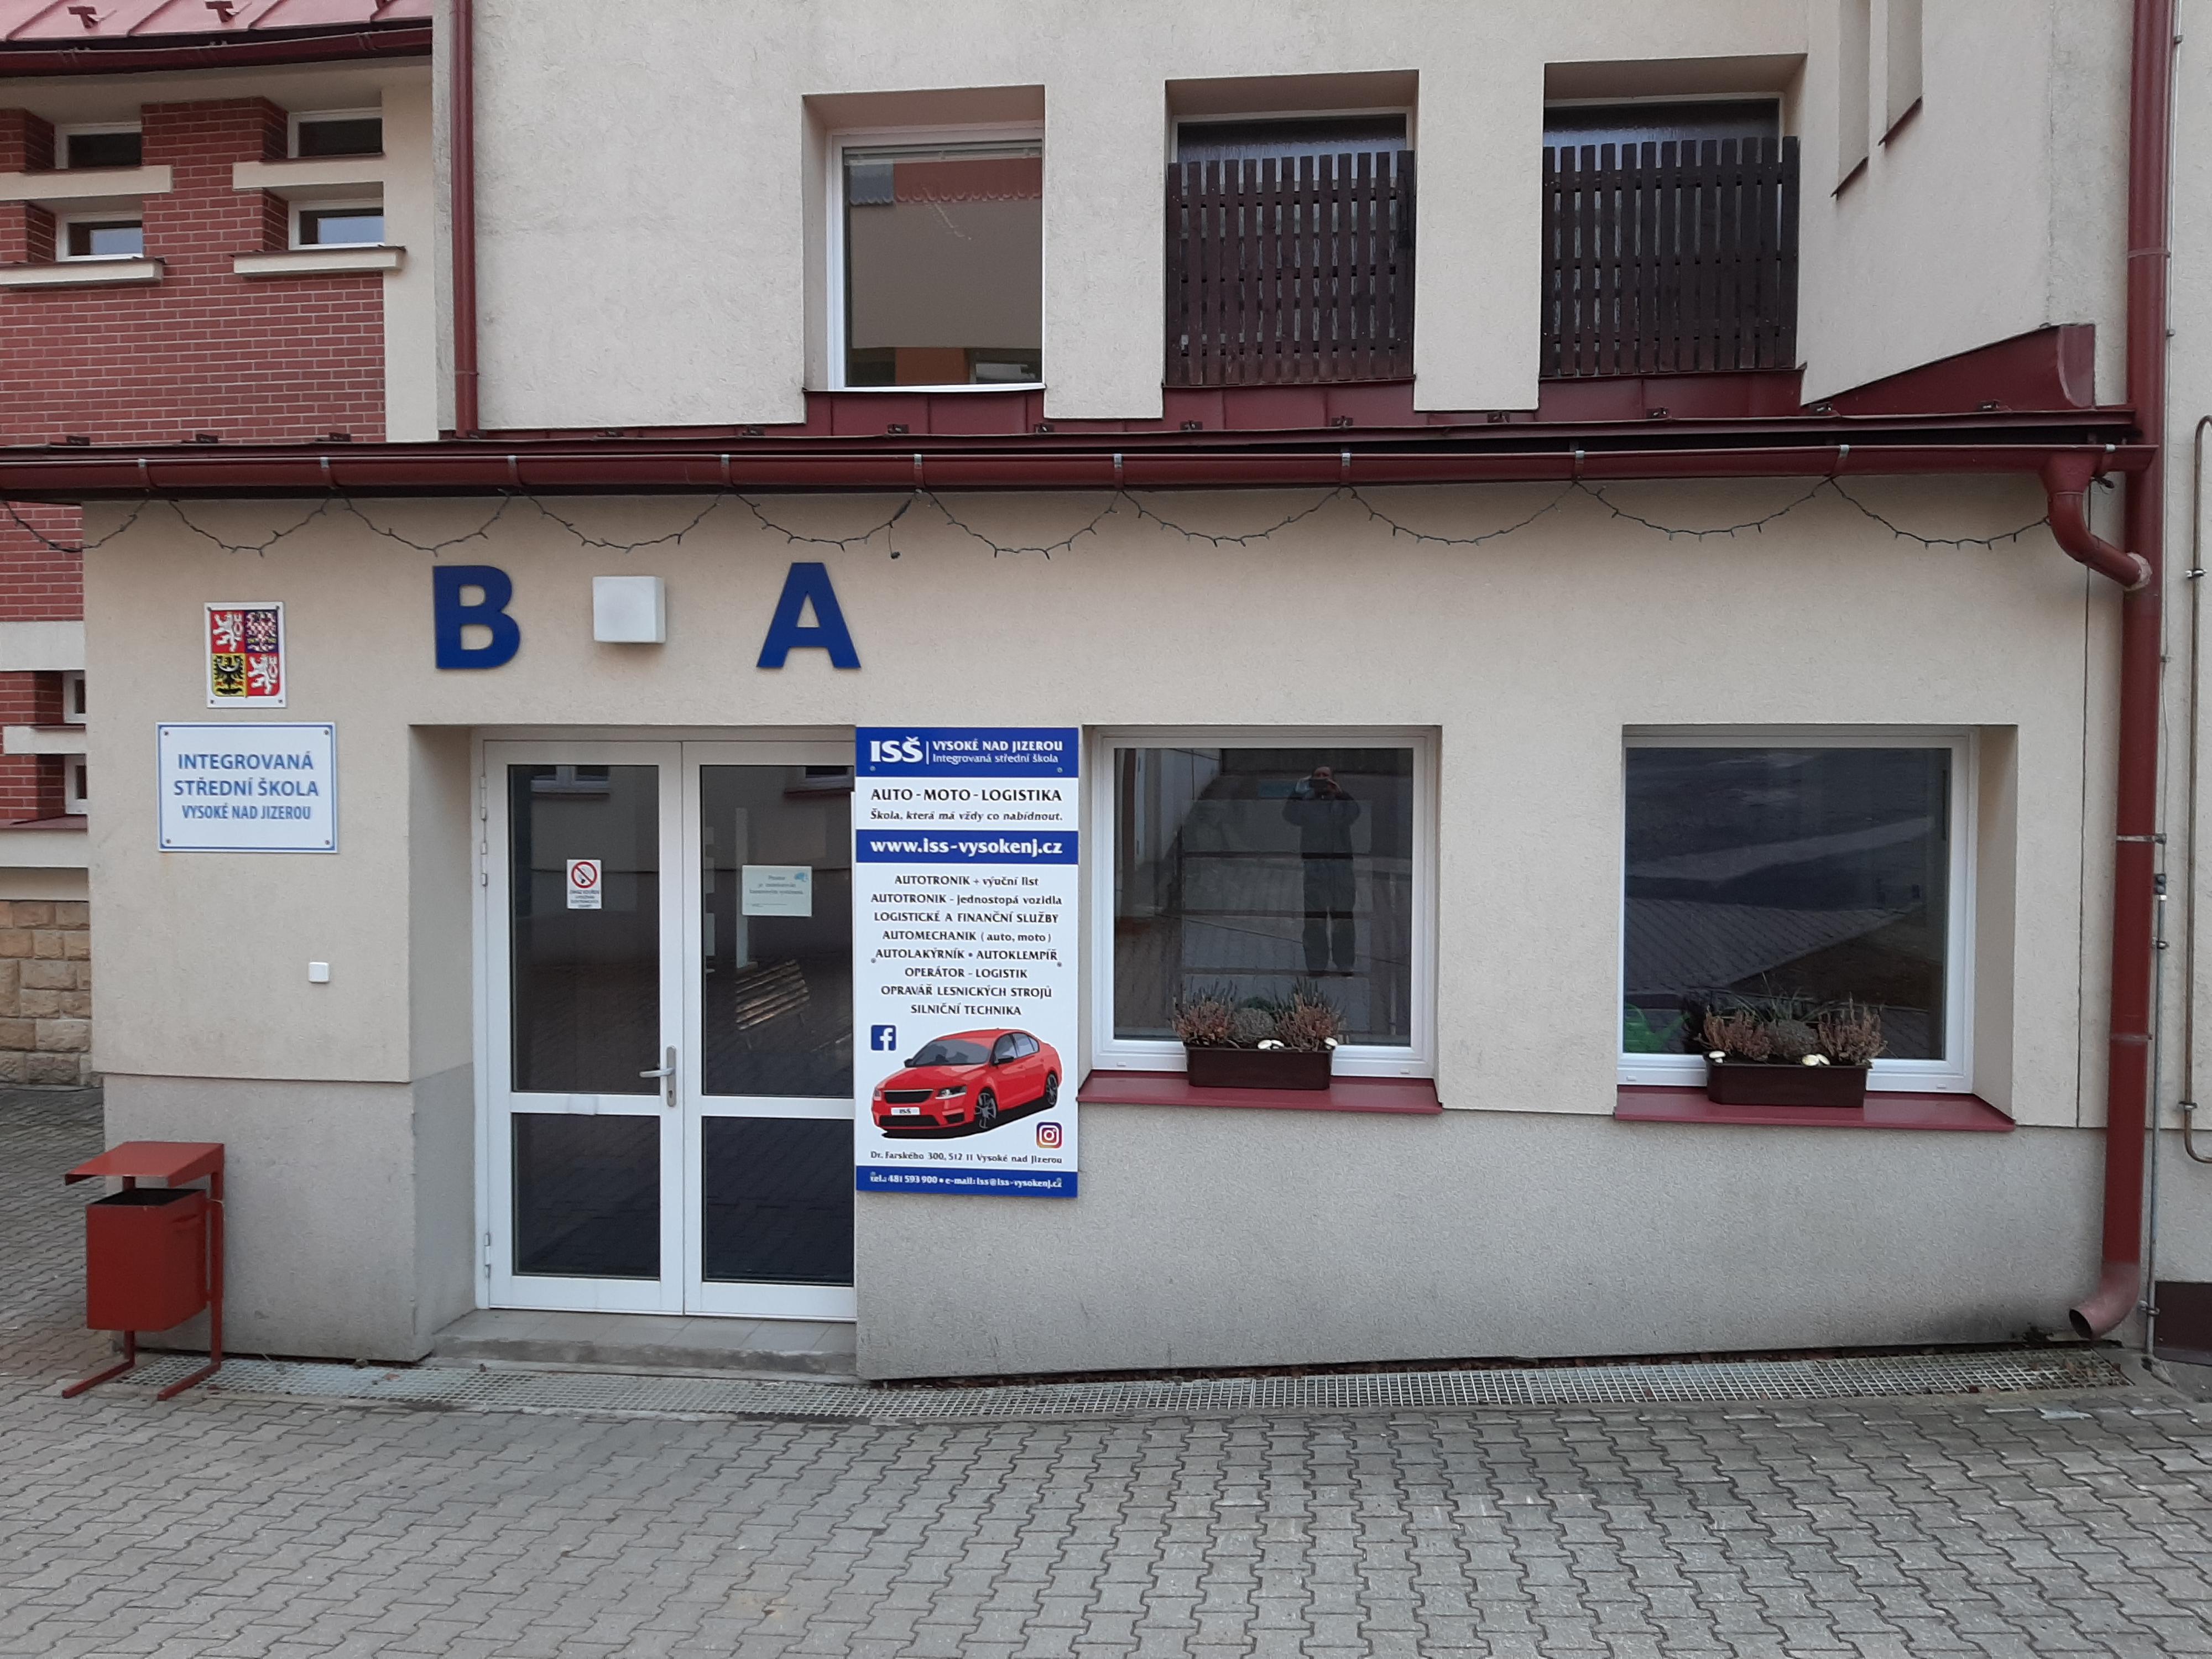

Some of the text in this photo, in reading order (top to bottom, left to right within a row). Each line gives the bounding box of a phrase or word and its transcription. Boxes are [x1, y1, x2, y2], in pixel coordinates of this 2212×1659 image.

[432, 565, 520, 669] B
[756, 562, 862, 668] A
[870, 737, 923, 763] ISŠ
[933, 738, 1062, 753] VYSOKÉ NAD JIZEROU
[178, 751, 314, 770] INTEGROVANÁ
[933, 754, 1058, 765] Integrovaná střední škola
[174, 777, 319, 796] STŘEDNÍ ŠKOLA
[871, 789, 912, 800] AUTO
[924, 790, 970, 801] MOTO
[982, 790, 1062, 801] LOGISTIKA
[182, 803, 311, 820] VYSOKÉ NAD JIZEROU
[870, 808, 902, 820] Škola,
[906, 810, 934, 820] která
[939, 811, 954, 820] má
[959, 810, 984, 822] vždy
[1004, 811, 1062, 821] nabídnout.
[870, 838, 1062, 857] www.iss-vysokenj.cz
[895, 876, 970, 885] AUTOTRONIK
[983, 877, 1018, 888] výuční
[1021, 877, 1039, 886] list
[870, 894, 946, 903] AUTOTRONIK
[957, 895, 1019, 905] jednostopá
[1022, 896, 1062, 905] vozidla
[874, 910, 1058, 923] LOGISTICKÉ A FINANČNÍ SLUŽBY
[882, 931, 977, 941] AUTOMECHANIK
[875, 948, 1058, 961] AUTOLAKÝRNÍK AUTOKLEMPÍŘ
[905, 966, 964, 977] OPERÁTOR
[975, 969, 1028, 979] LOGISTIK
[881, 983, 1052, 999] OPRAVÁŘ LESNICKÝCH STROJŮ
[911, 1002, 1021, 1015] SILNIČNÍ TECHNIKA
[977, 1154, 1008, 1162] Vysoké
[1031, 1155, 1062, 1164] Jizerou
